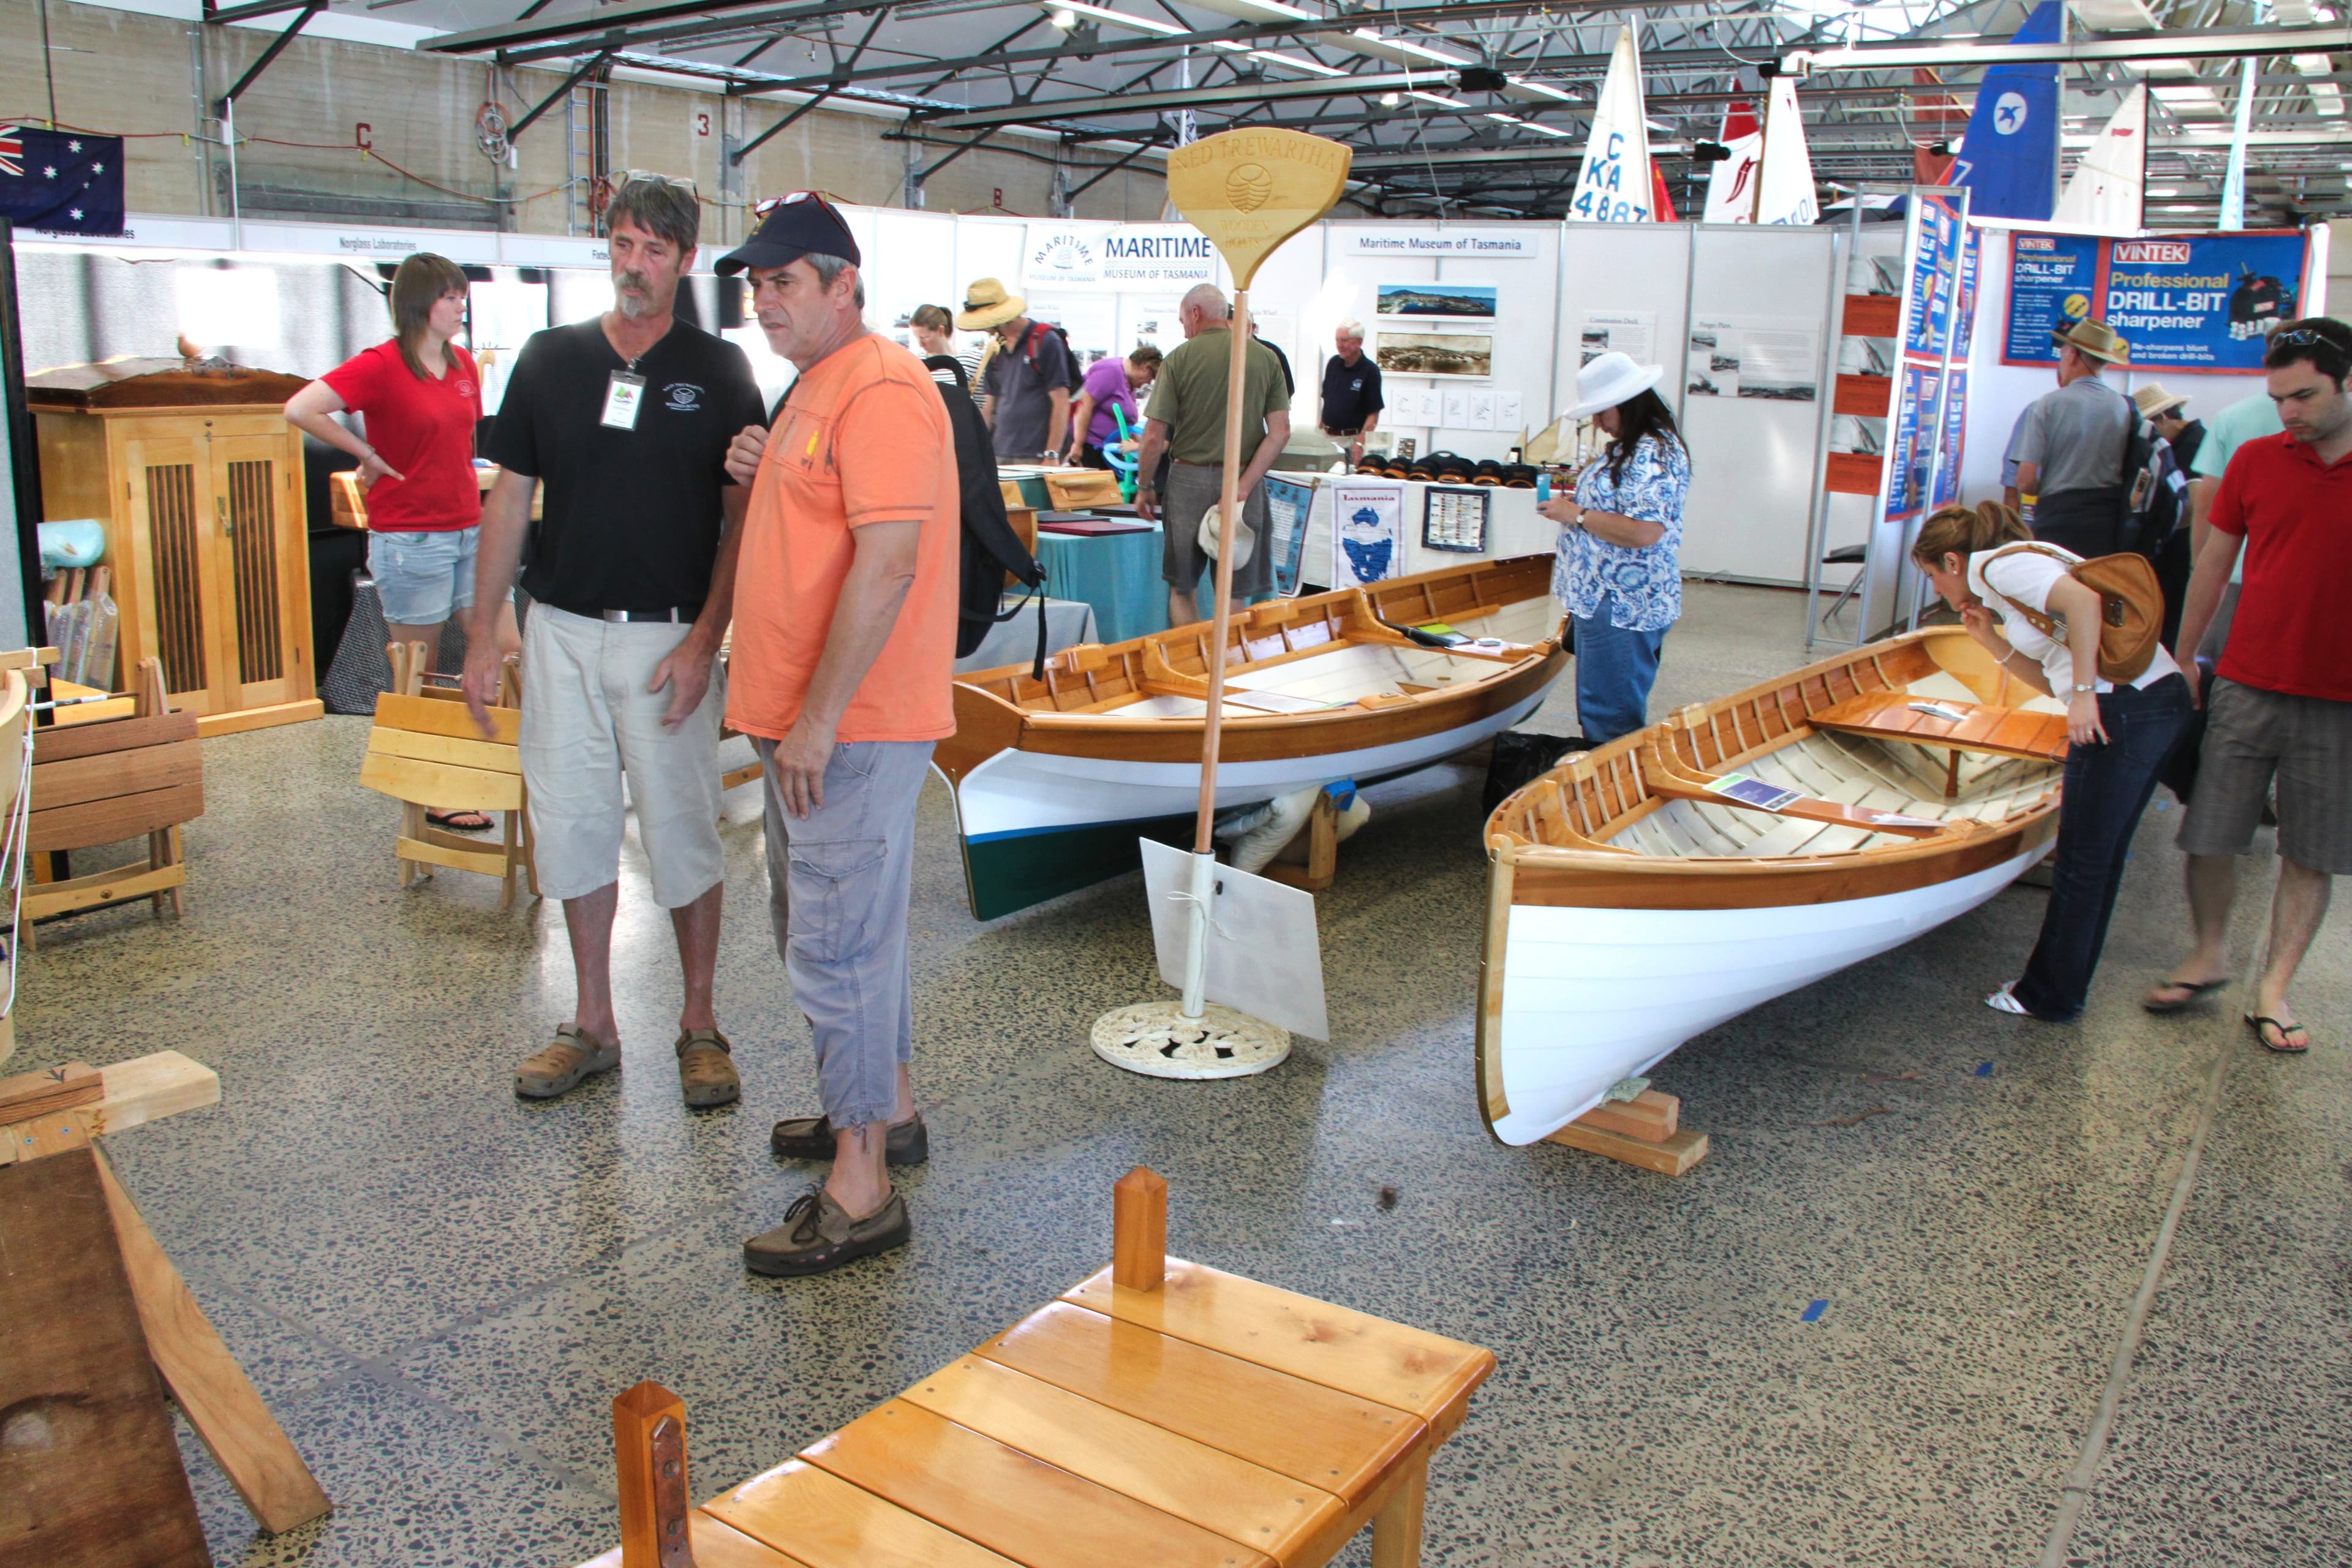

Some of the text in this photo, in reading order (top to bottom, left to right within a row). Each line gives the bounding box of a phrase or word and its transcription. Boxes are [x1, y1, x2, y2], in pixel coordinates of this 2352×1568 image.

[698, 114, 709, 136] 3
[356, 123, 371, 149] C
[1608, 133, 1624, 160] C
[1175, 145, 1213, 169] NED
[1586, 157, 1621, 192] KA
[993, 188, 1003, 206] B
[1575, 191, 1647, 222] 4887
[339, 236, 417, 252] Norglass Laboratories
[1035, 235, 1093, 266] MARITIME
[1106, 237, 1211, 257] MARITIME
[1359, 238, 1521, 250] Maritime Museum of Tasmania
[2019, 239, 2052, 250] VINTEK
[2117, 244, 2186, 262] VINTEK
[2016, 254, 2076, 263] Professional
[1104, 270, 1208, 279] MUSEUM OF TASMANIA
[2015, 263, 2075, 274] DRILL-BIT
[2014, 274, 2065, 284] sharpener
[2110, 271, 2230, 288] Professional
[2107, 291, 2227, 311] DRILL-BIT
[2106, 312, 2205, 331] sharpener
[2185, 343, 2209, 352] blunt
